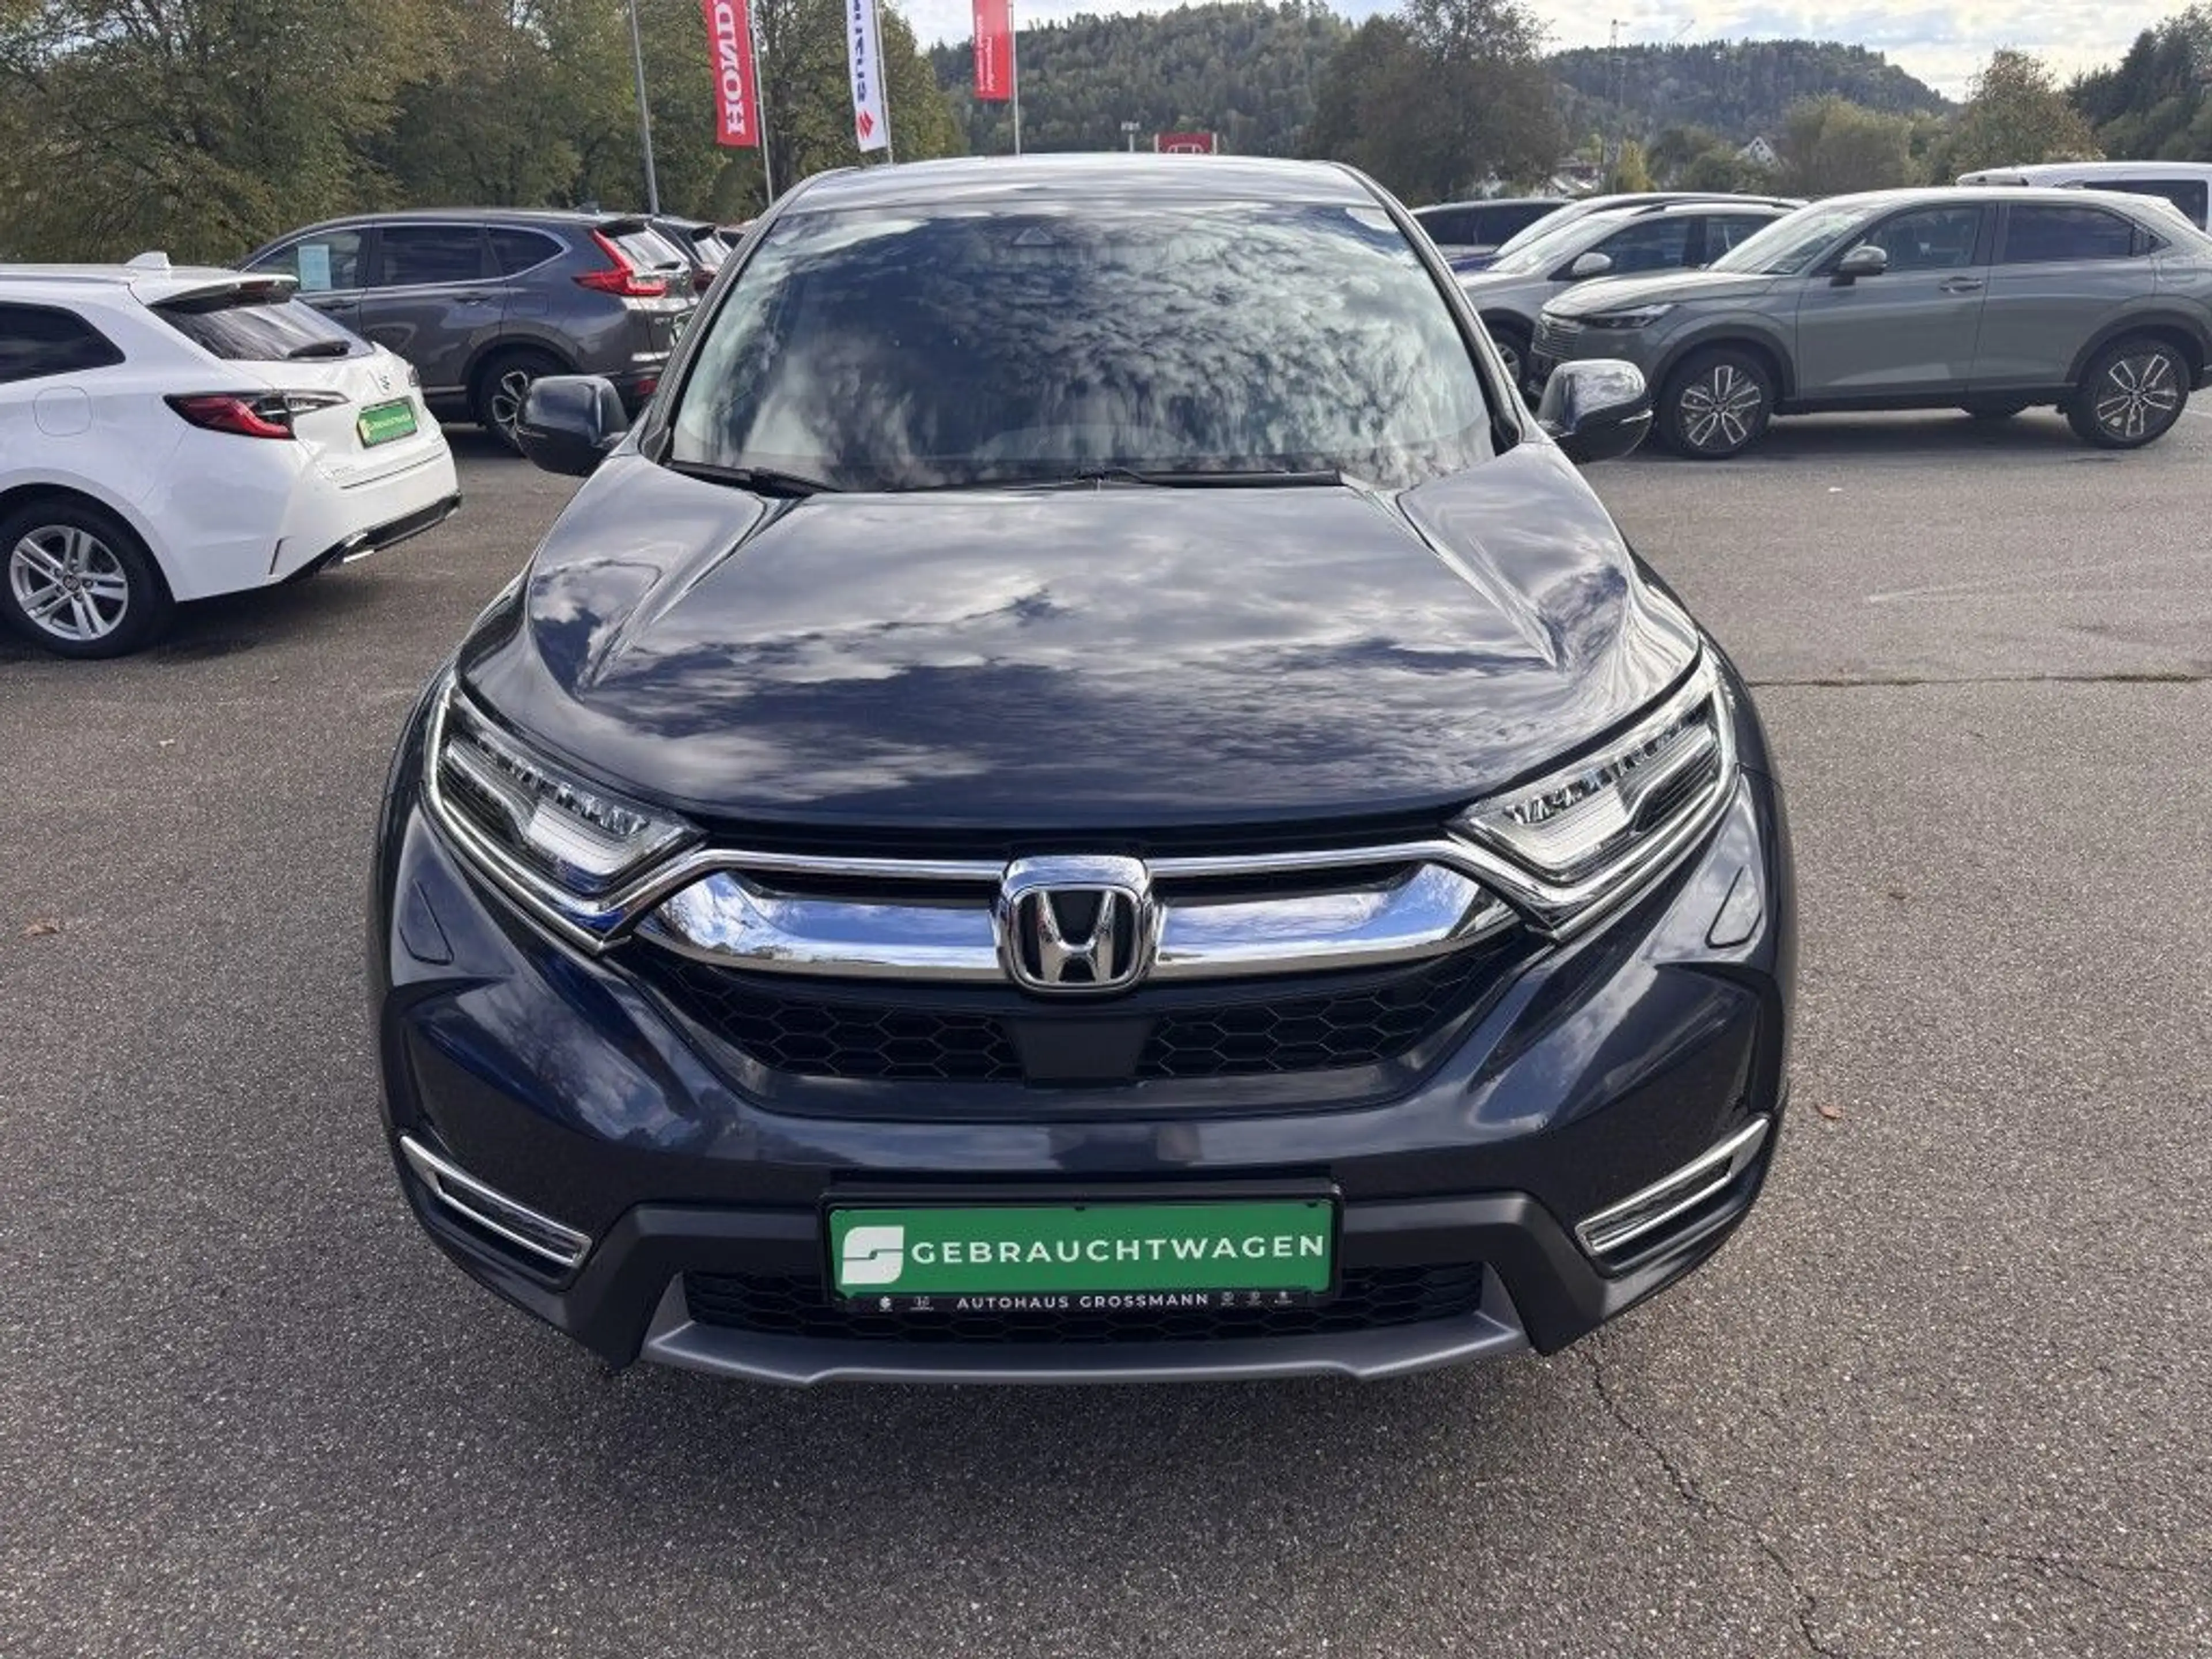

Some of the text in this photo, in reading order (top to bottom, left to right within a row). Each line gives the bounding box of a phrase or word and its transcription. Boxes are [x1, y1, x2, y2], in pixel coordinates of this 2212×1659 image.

[911, 1235, 1324, 1264] GEBRAUCHTWAGEN
[957, 1294, 1209, 1309] AUTOHAUS GROSSMANN
